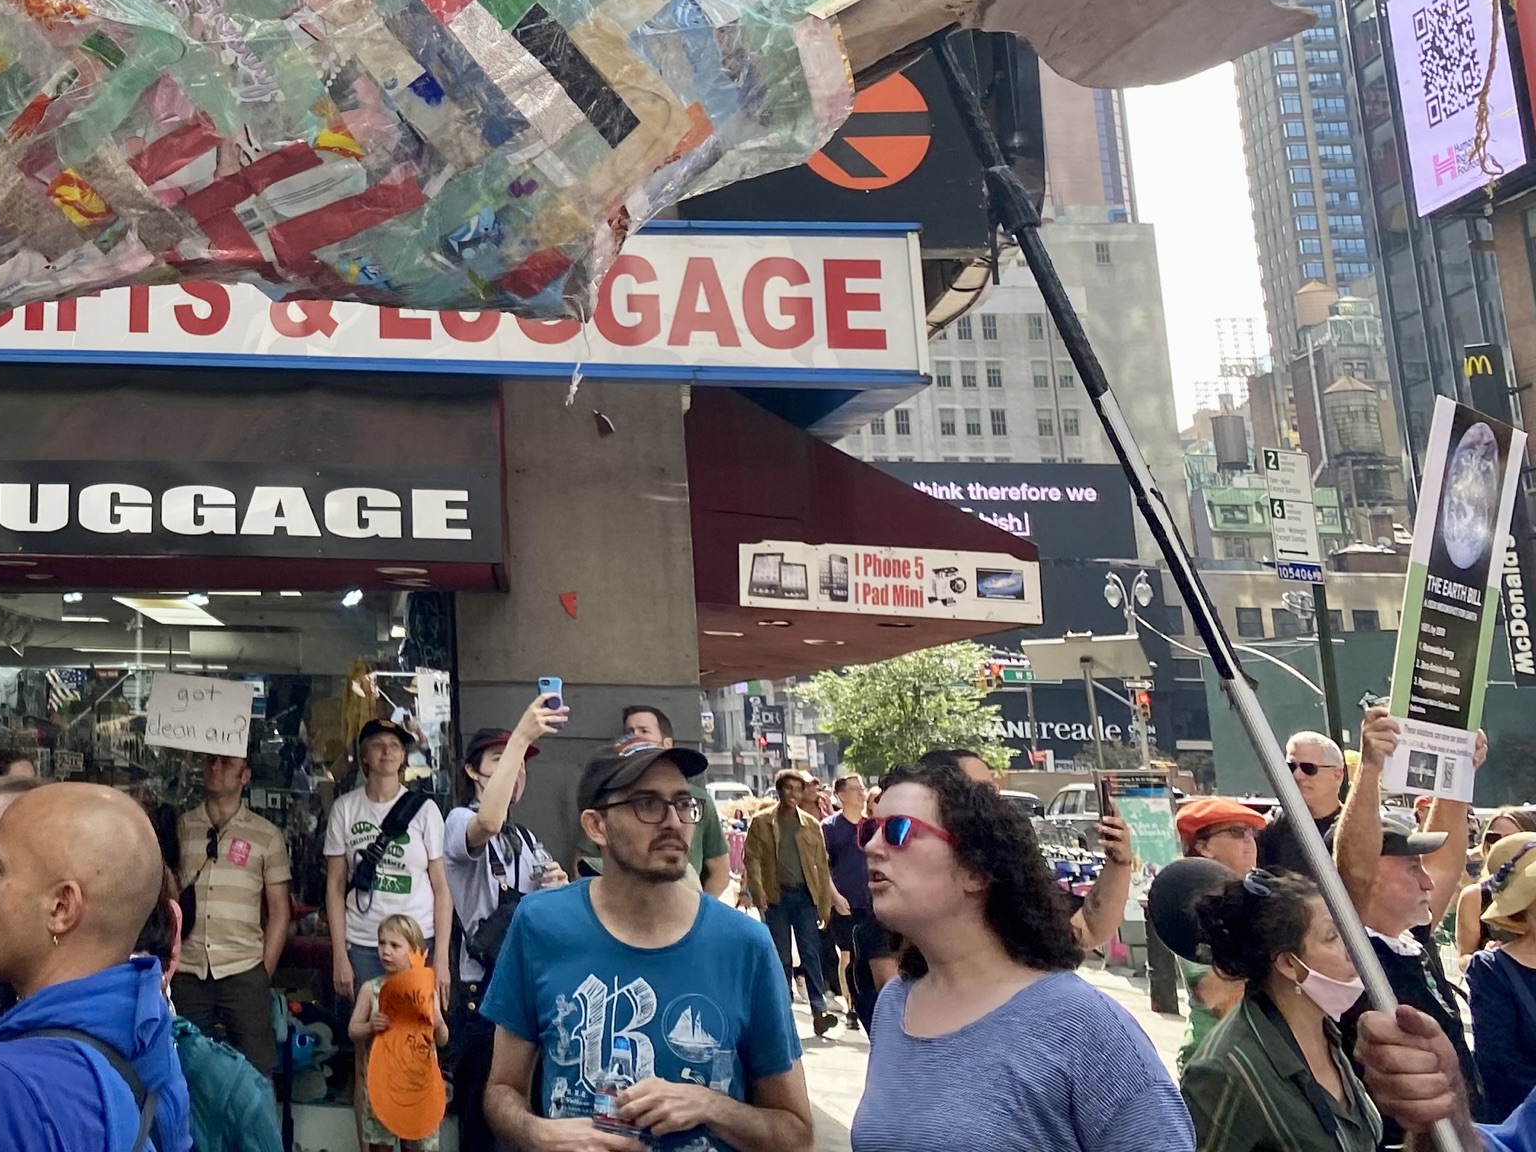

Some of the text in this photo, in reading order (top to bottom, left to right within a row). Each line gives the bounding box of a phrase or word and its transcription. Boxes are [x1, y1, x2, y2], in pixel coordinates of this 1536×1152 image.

[378, 258, 889, 351] GAGE
[1267, 451, 1277, 469] 2
[967, 482, 1061, 501] therefore
[1066, 487, 1097, 501] we
[1273, 500, 1283, 517] 6
[863, 553, 911, 579] Phone
[914, 556, 924, 580] 5
[862, 583, 889, 606] Pad
[892, 584, 924, 608] Mini
[1427, 574, 1482, 607] THE EARTH BILL
[1502, 534, 1535, 675] McDonalds
[171, 684, 222, 712] got
[148, 713, 247, 744] clean air?
